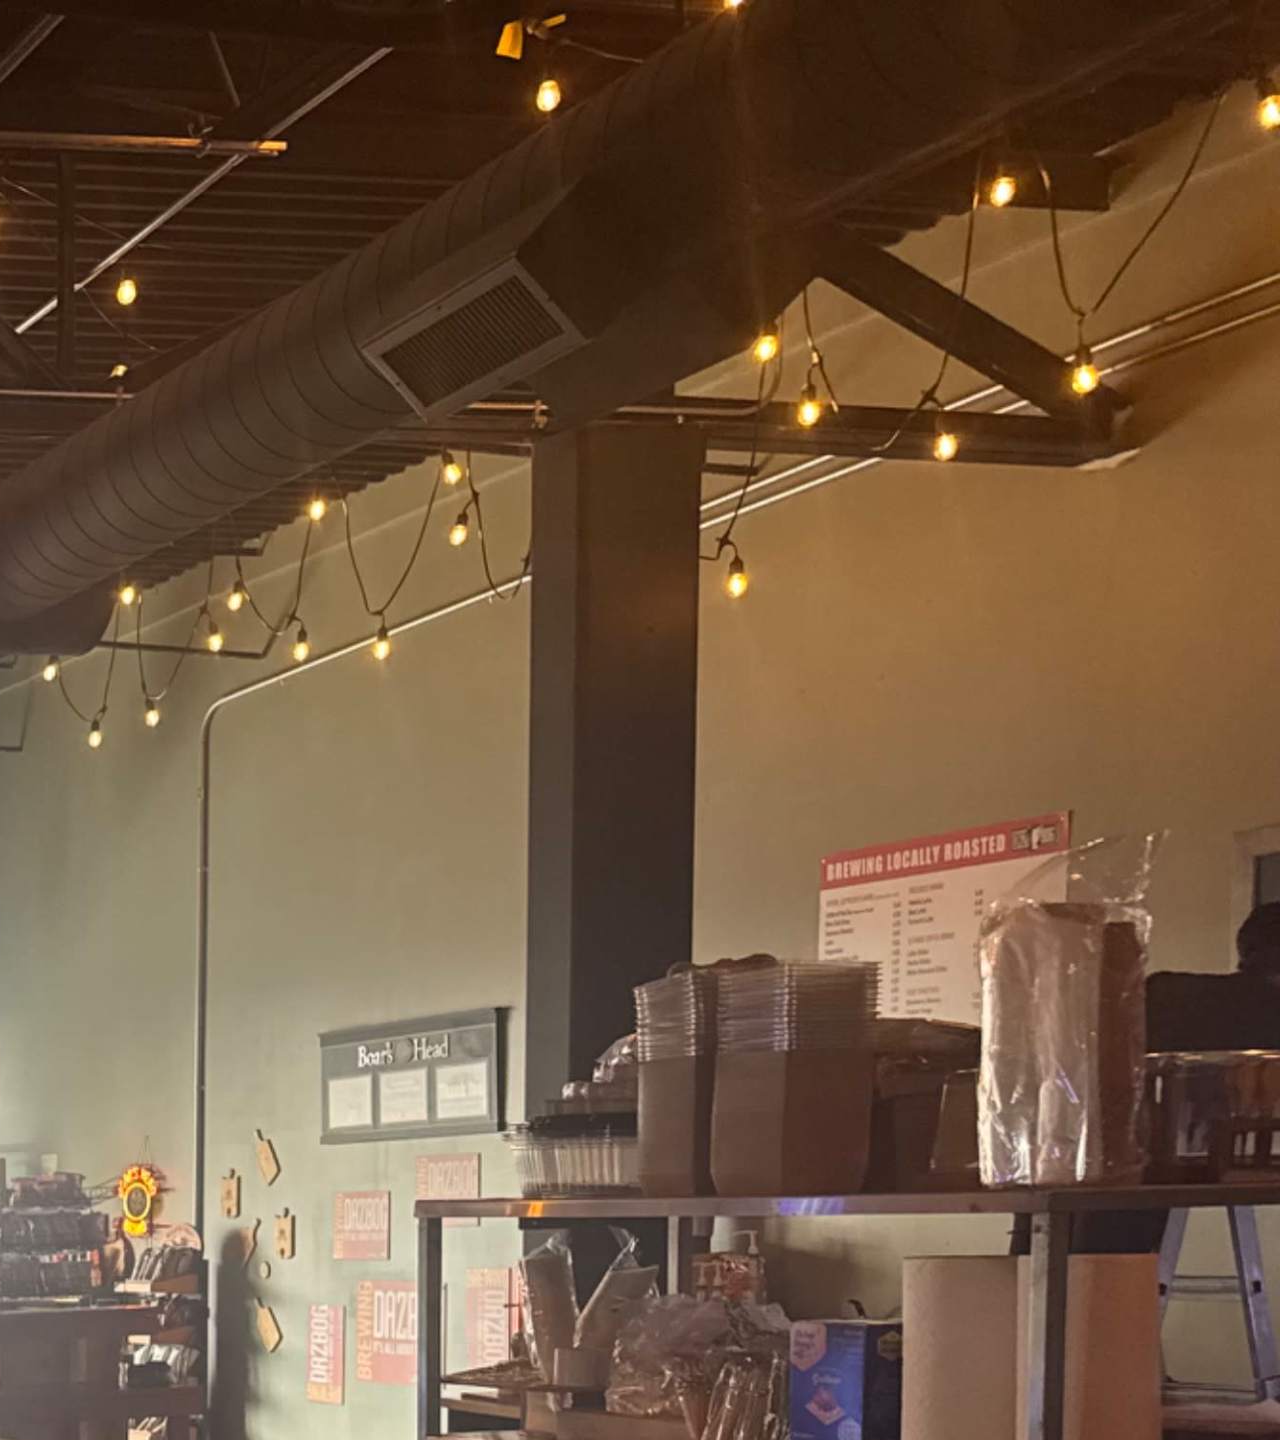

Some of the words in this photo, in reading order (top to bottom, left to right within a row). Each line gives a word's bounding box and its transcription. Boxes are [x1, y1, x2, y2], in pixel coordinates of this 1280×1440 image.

[826, 855, 884, 882] BREWING
[886, 845, 940, 872] LOCALLY
[944, 833, 1007, 861] ROASTED
[412, 1032, 449, 1062] Head
[357, 1281, 373, 1380] BREWING
[373, 1290, 418, 1339] DAZB
[483, 1289, 506, 1360] DAZBO
